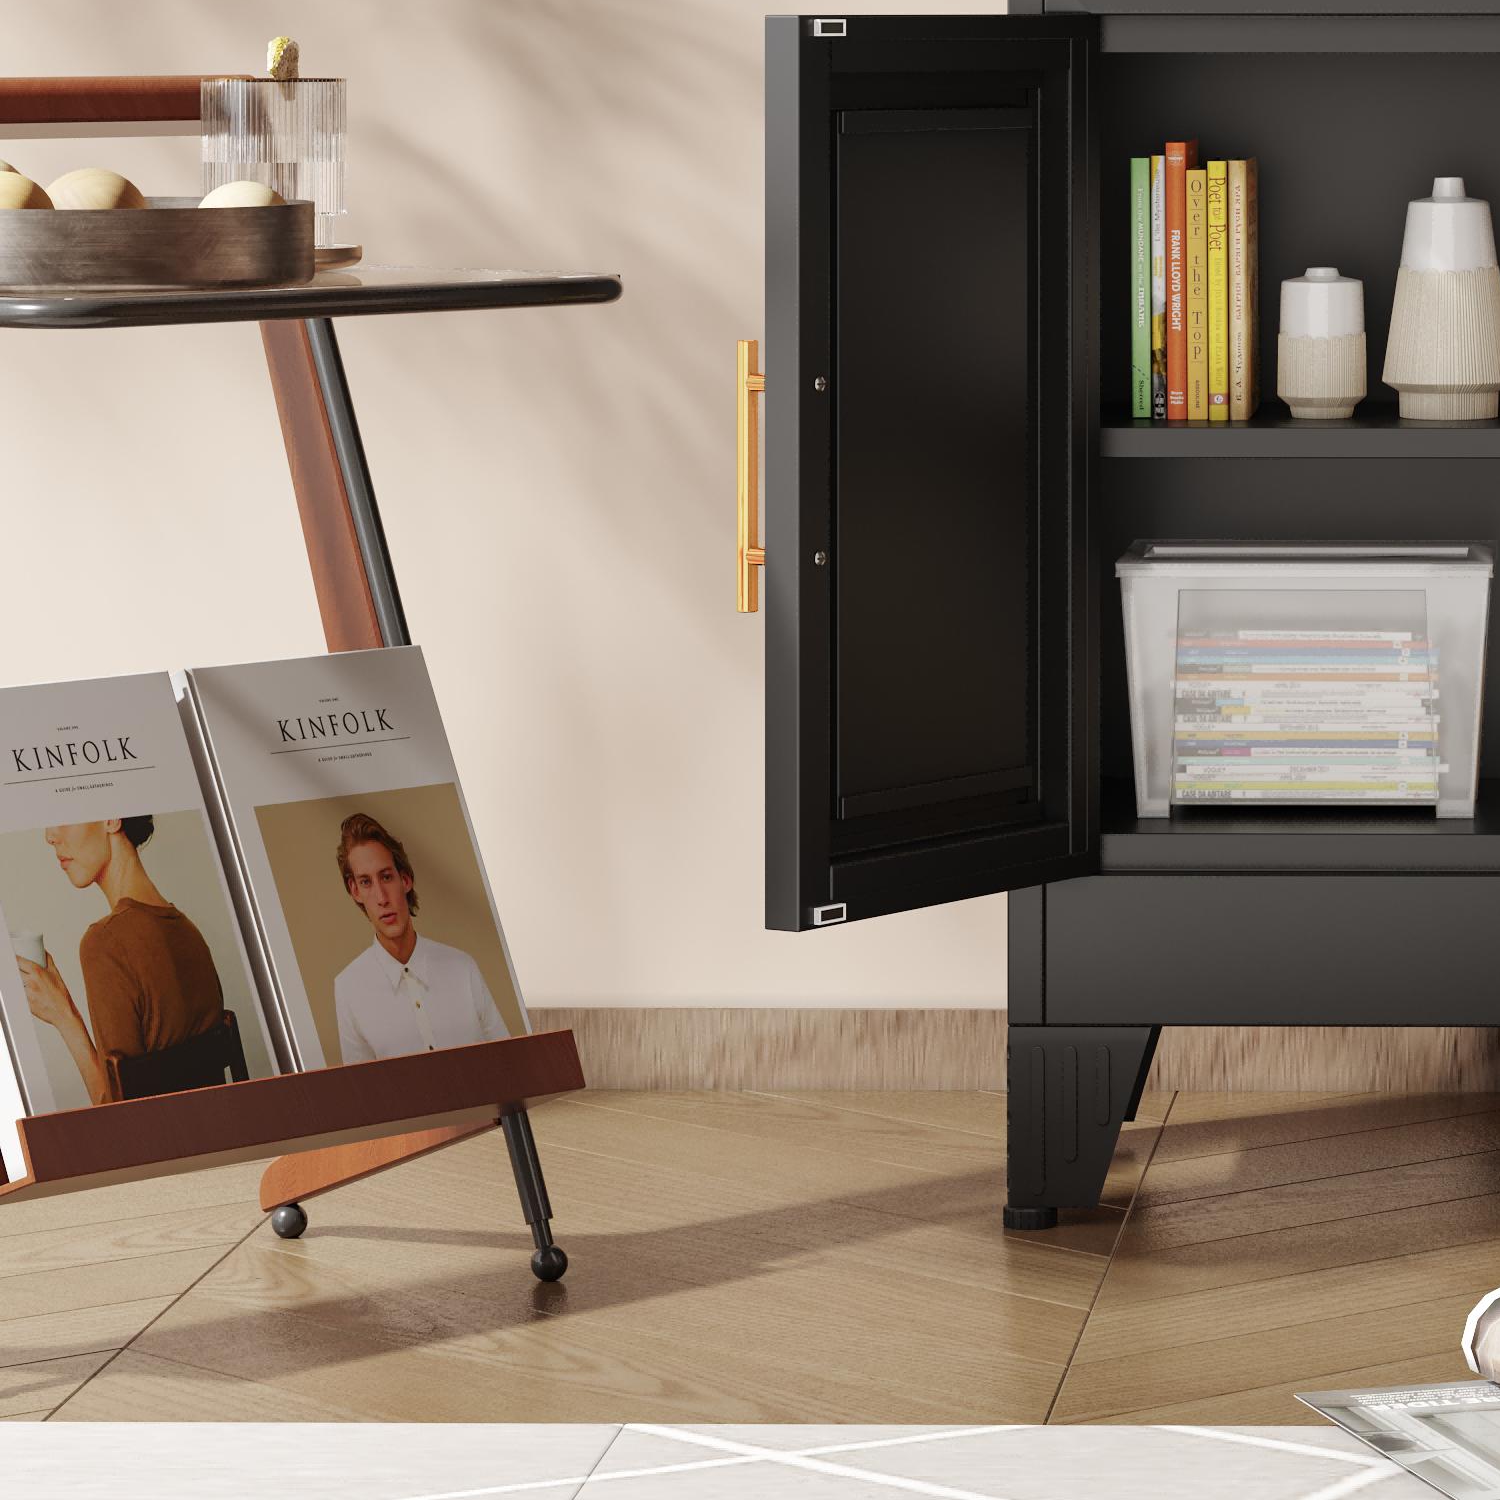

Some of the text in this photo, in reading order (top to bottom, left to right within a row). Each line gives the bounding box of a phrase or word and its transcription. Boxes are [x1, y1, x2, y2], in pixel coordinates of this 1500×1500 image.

[1209, 176, 1226, 252] Poet Poet
[1171, 229, 1182, 332] FRANK LLOYD WRIGHT
[277, 708, 395, 742] KINFOLK
[11, 736, 138, 772] KINFOLK
